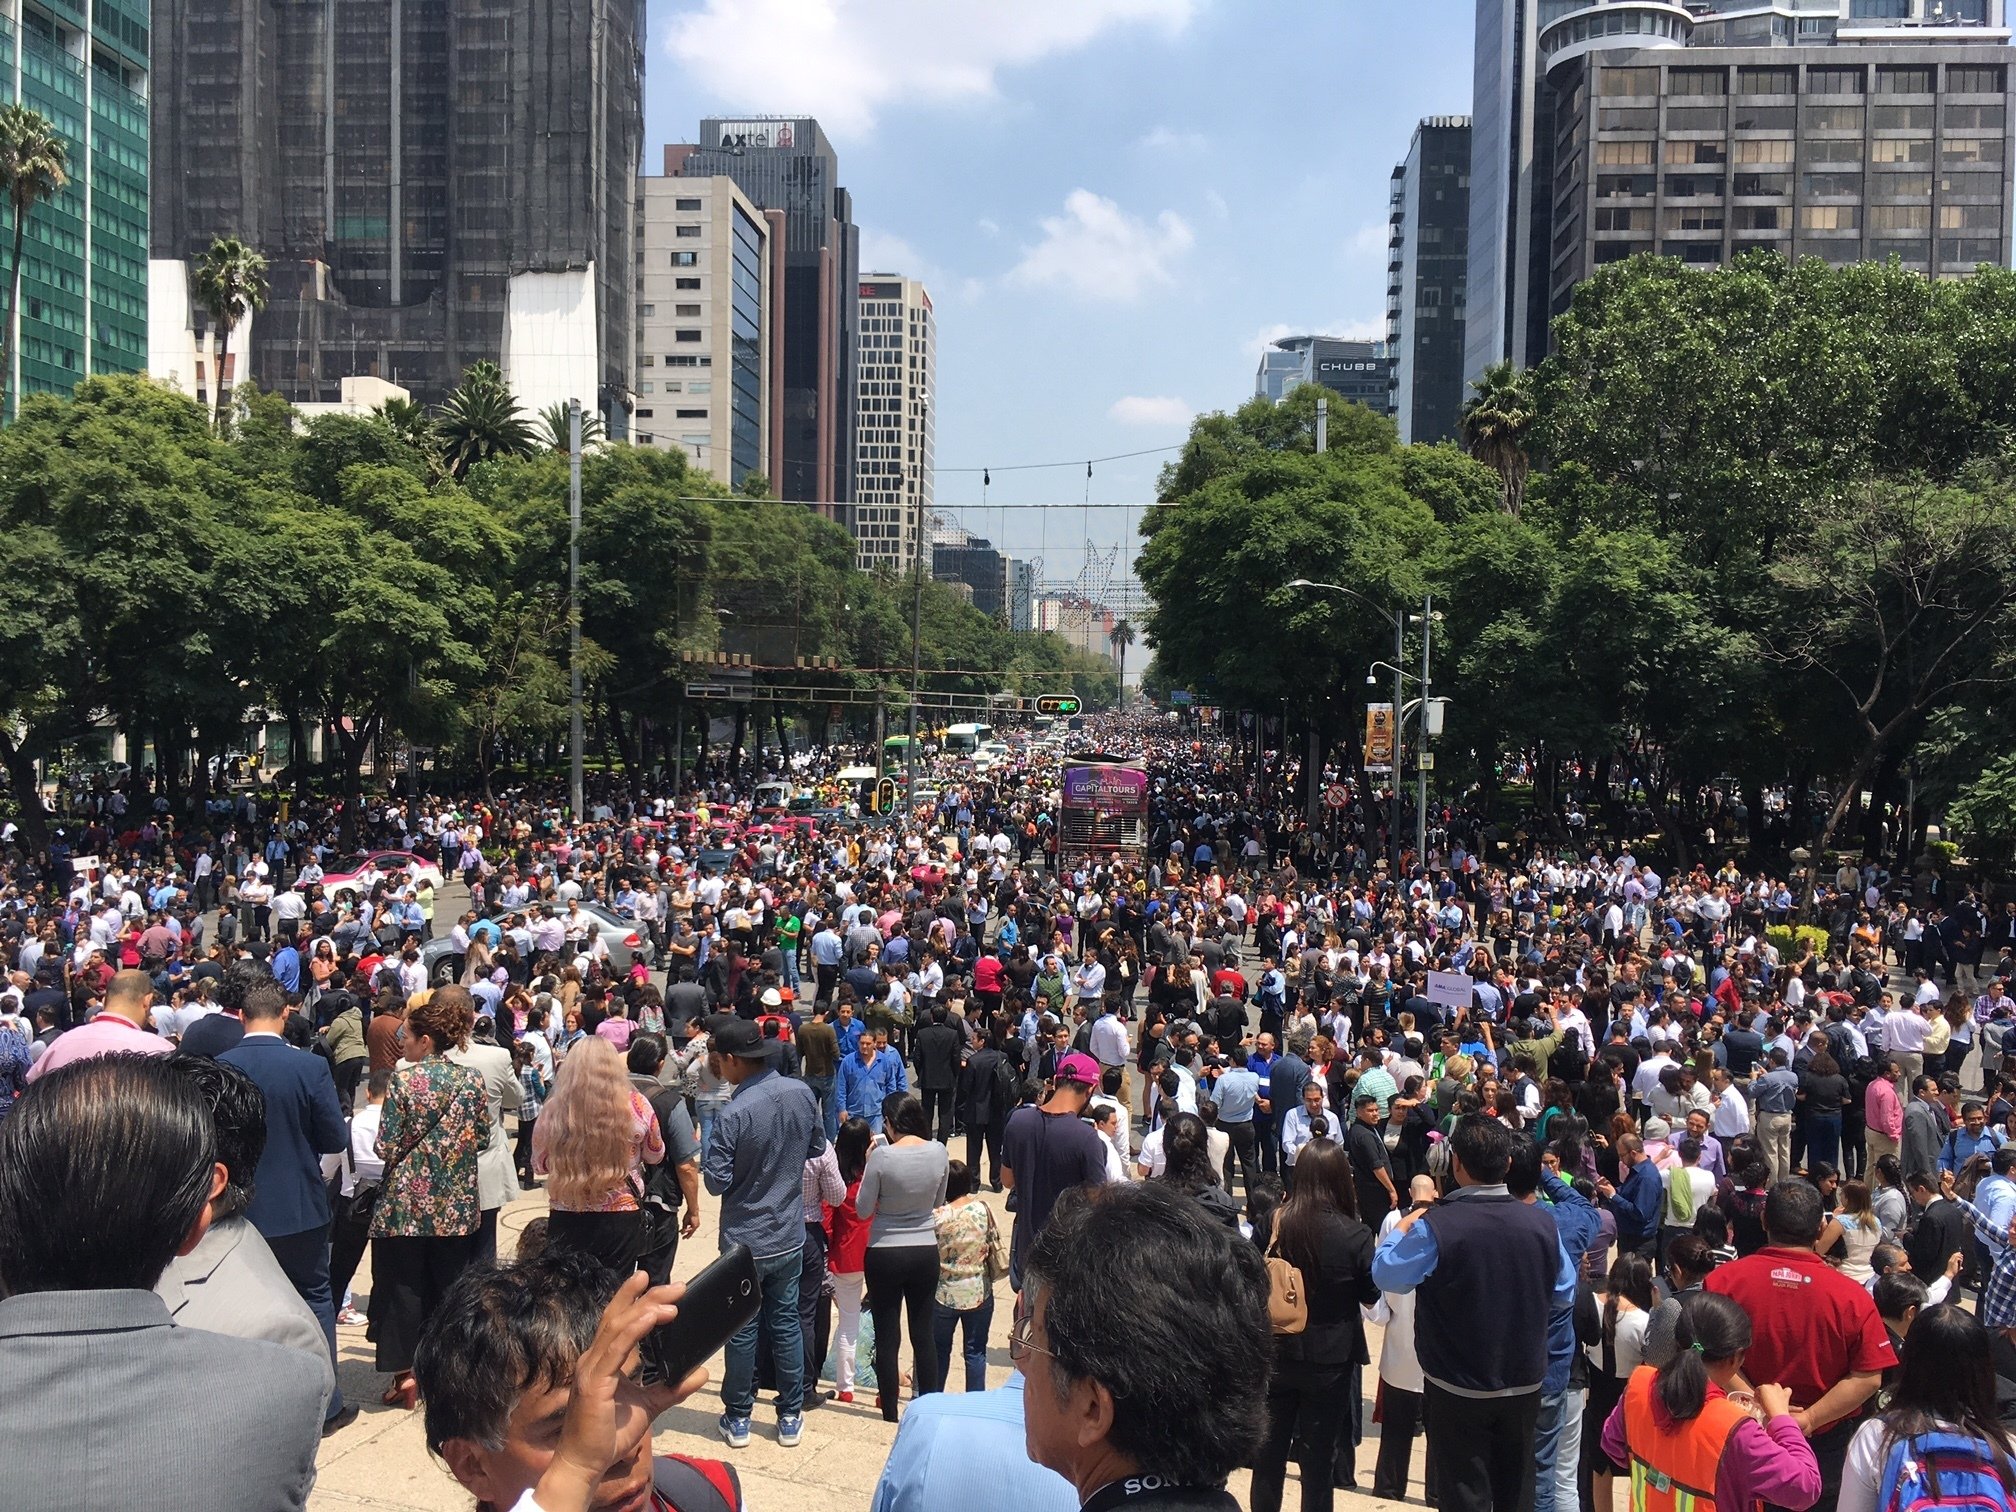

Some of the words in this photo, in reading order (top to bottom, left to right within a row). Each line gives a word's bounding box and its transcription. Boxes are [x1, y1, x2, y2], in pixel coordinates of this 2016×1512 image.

[1320, 362, 1376, 371] CHUBB
[1075, 784, 1136, 794] CAPITALTOURS
[1124, 1473, 1192, 1495] SON
